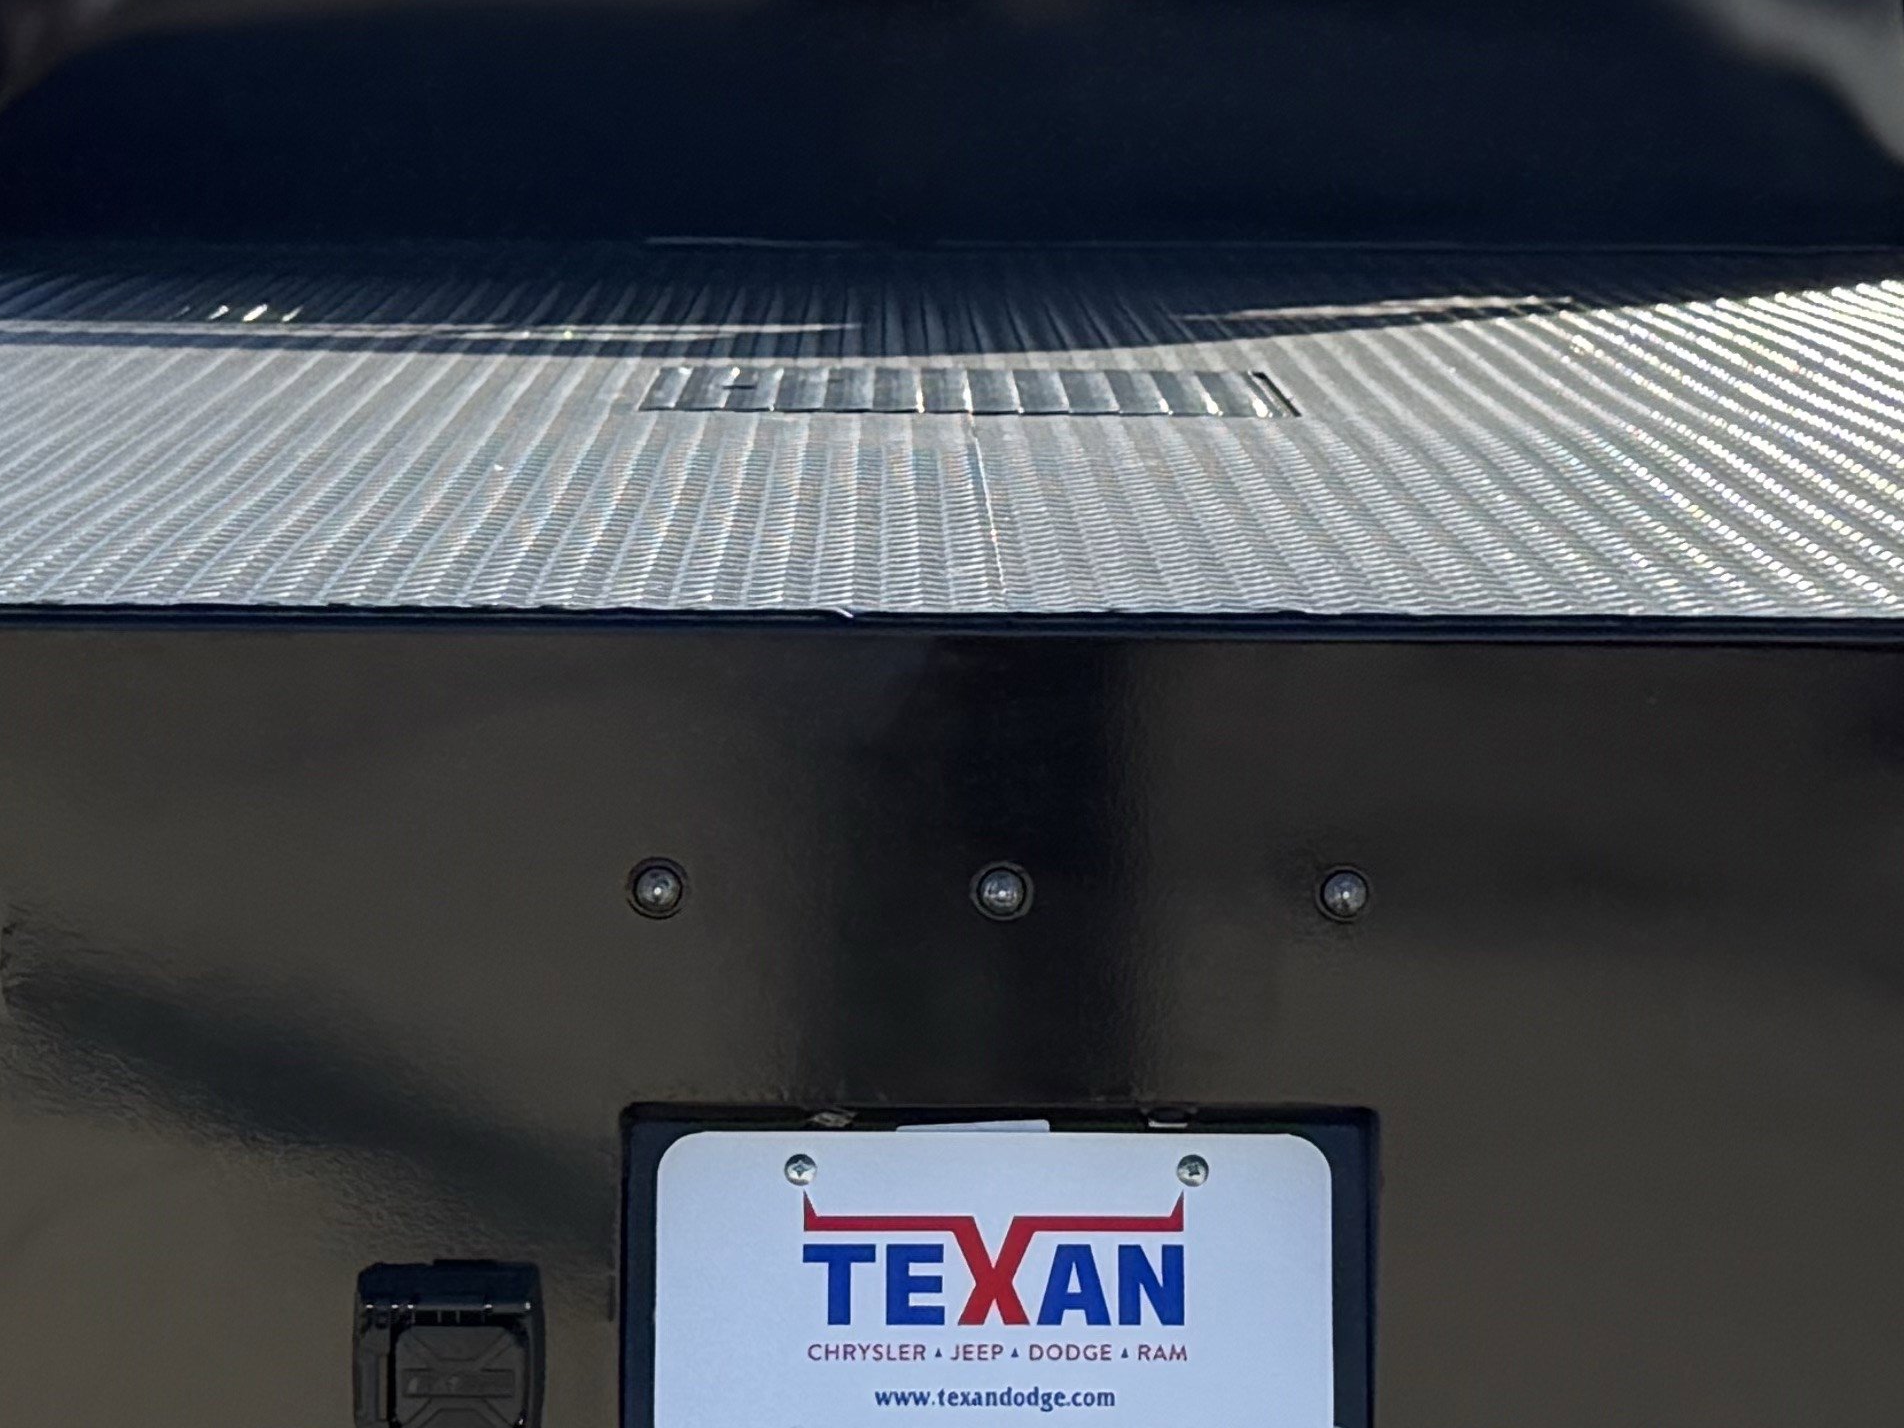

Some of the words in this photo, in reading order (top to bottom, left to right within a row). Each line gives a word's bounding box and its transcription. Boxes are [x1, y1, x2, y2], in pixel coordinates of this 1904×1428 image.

[802, 1216, 1186, 1326] TEXAN
[806, 1343, 927, 1362] CHRYSLER
[949, 1343, 1004, 1362] JEEP
[1028, 1343, 1113, 1362] DODGE
[1137, 1343, 1188, 1362] RAM
[874, 1386, 1116, 1412] www.texandodge.com
